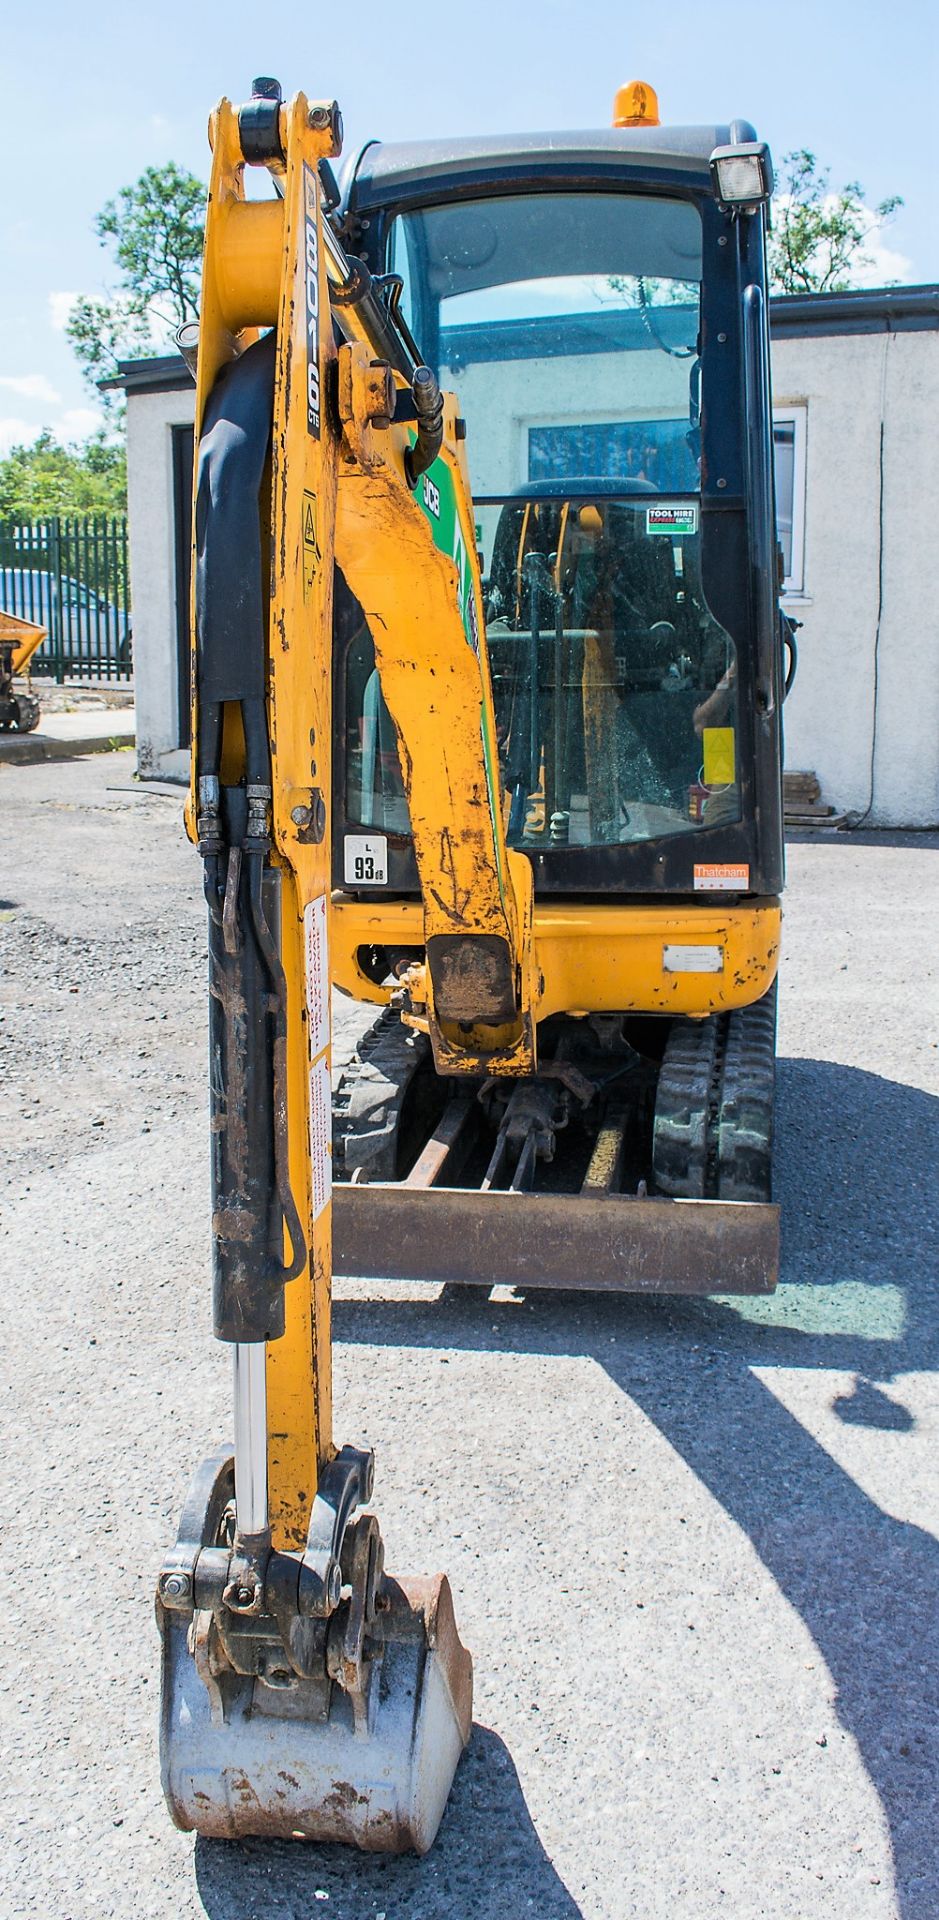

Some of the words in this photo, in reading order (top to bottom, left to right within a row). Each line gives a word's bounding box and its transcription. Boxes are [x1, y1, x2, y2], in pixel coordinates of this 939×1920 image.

[306, 222, 320, 411] 8016
[423, 473, 440, 519] JCB
[650, 510, 673, 518] TOOL
[355, 857, 374, 880] 93
[695, 866, 746, 878] Thatcham
[309, 1008, 314, 1035] DO
